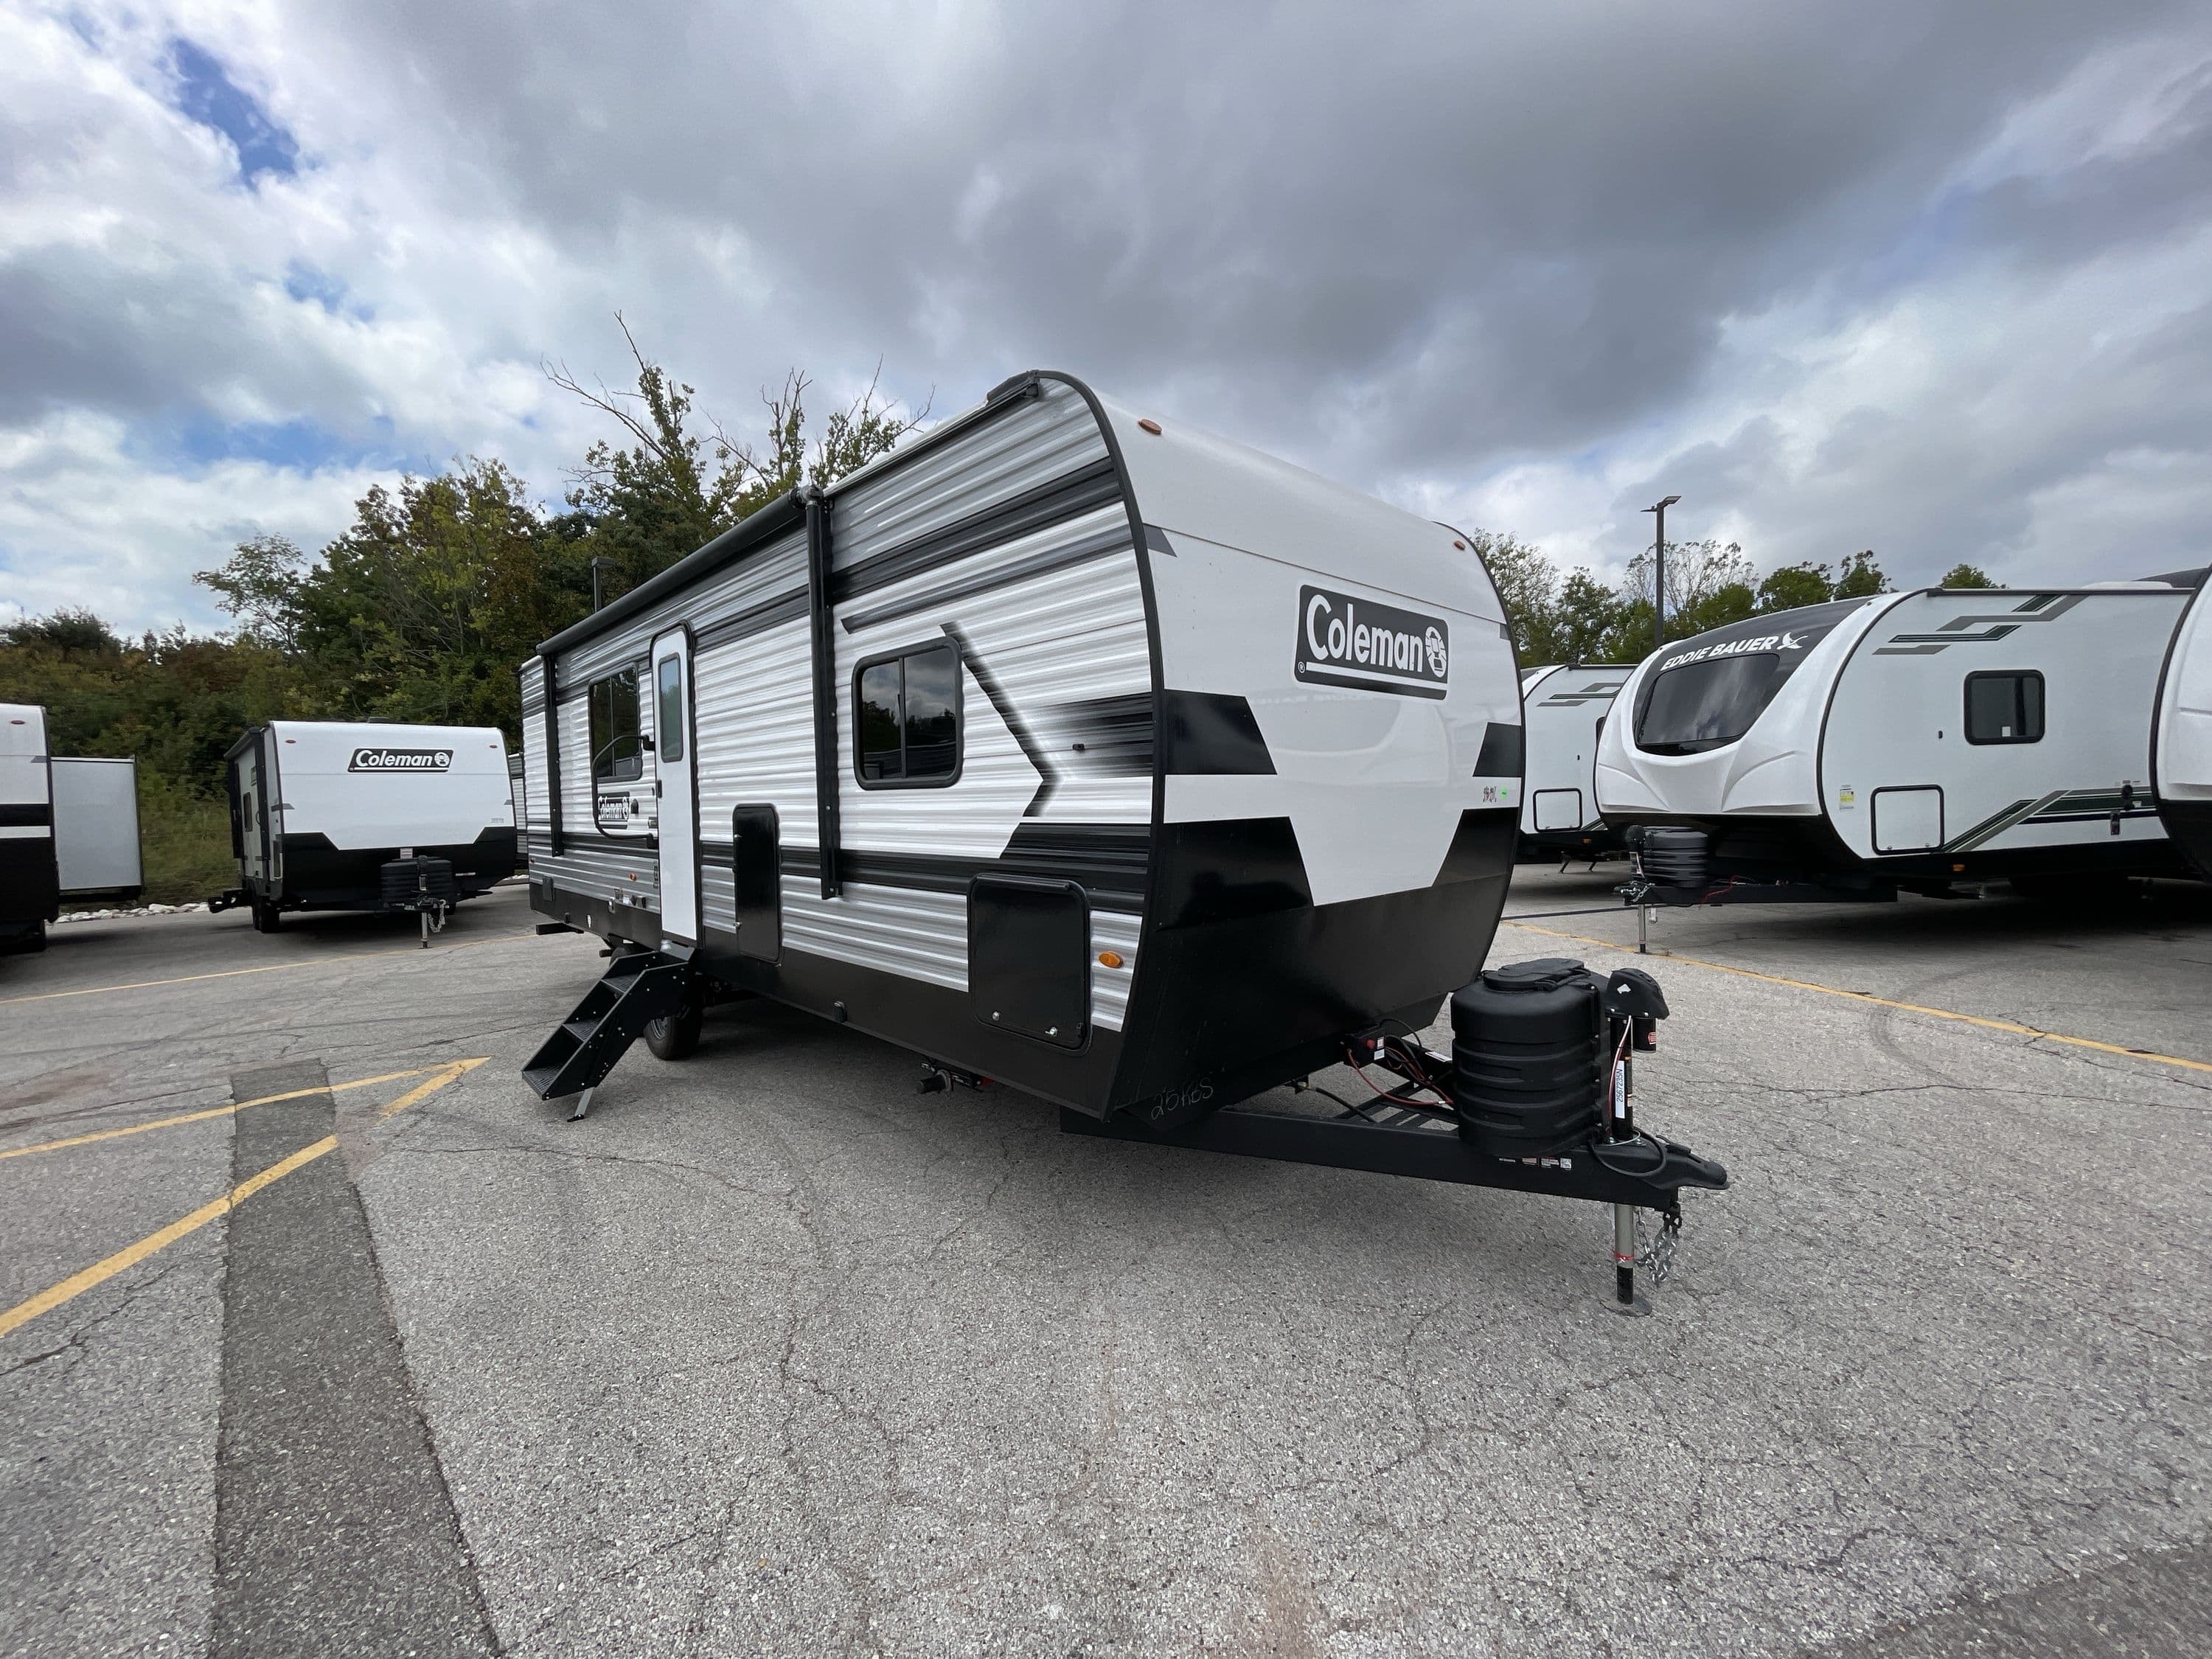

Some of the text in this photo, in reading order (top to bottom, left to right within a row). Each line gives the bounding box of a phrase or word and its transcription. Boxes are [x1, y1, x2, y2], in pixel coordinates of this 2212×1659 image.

[1307, 594, 1424, 672] Coleman
[1660, 636, 1779, 672] EDDIE BAUER
[355, 749, 433, 767] Coleman
